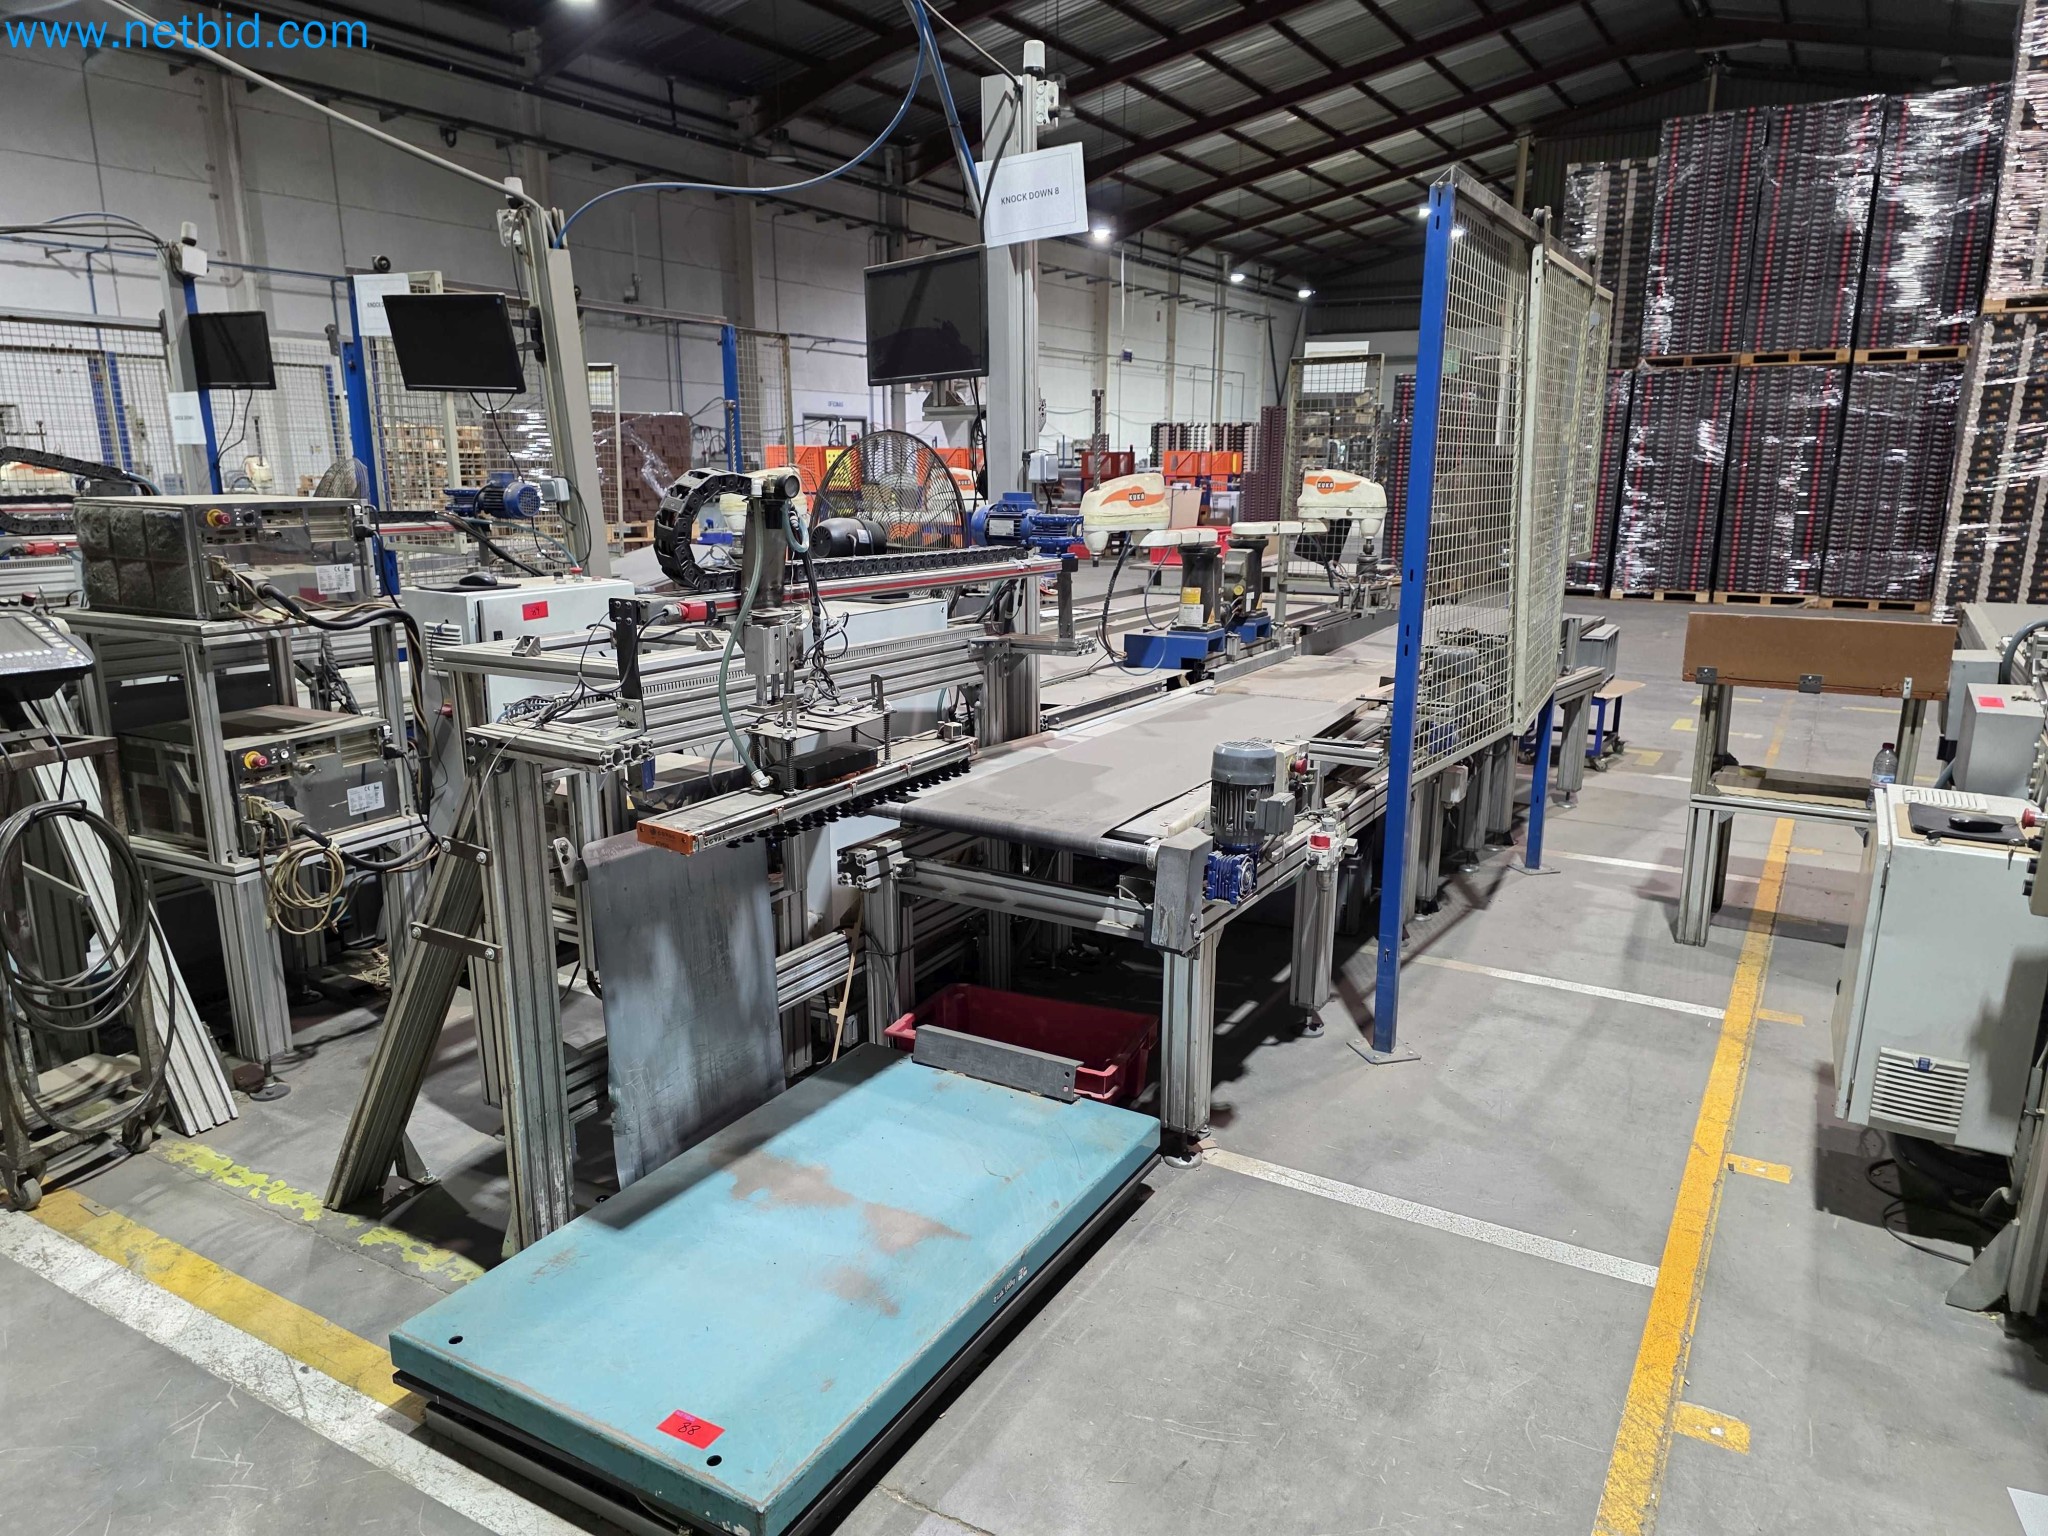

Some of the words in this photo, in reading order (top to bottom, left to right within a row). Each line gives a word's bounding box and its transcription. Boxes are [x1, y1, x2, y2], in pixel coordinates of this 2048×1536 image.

[1001, 193, 1028, 205] KNOCK
[1029, 188, 1053, 200] DOWN
[1054, 187, 1060, 195] 8
[1129, 493, 1145, 501] KUKA
[678, 1422, 701, 1435] 88
